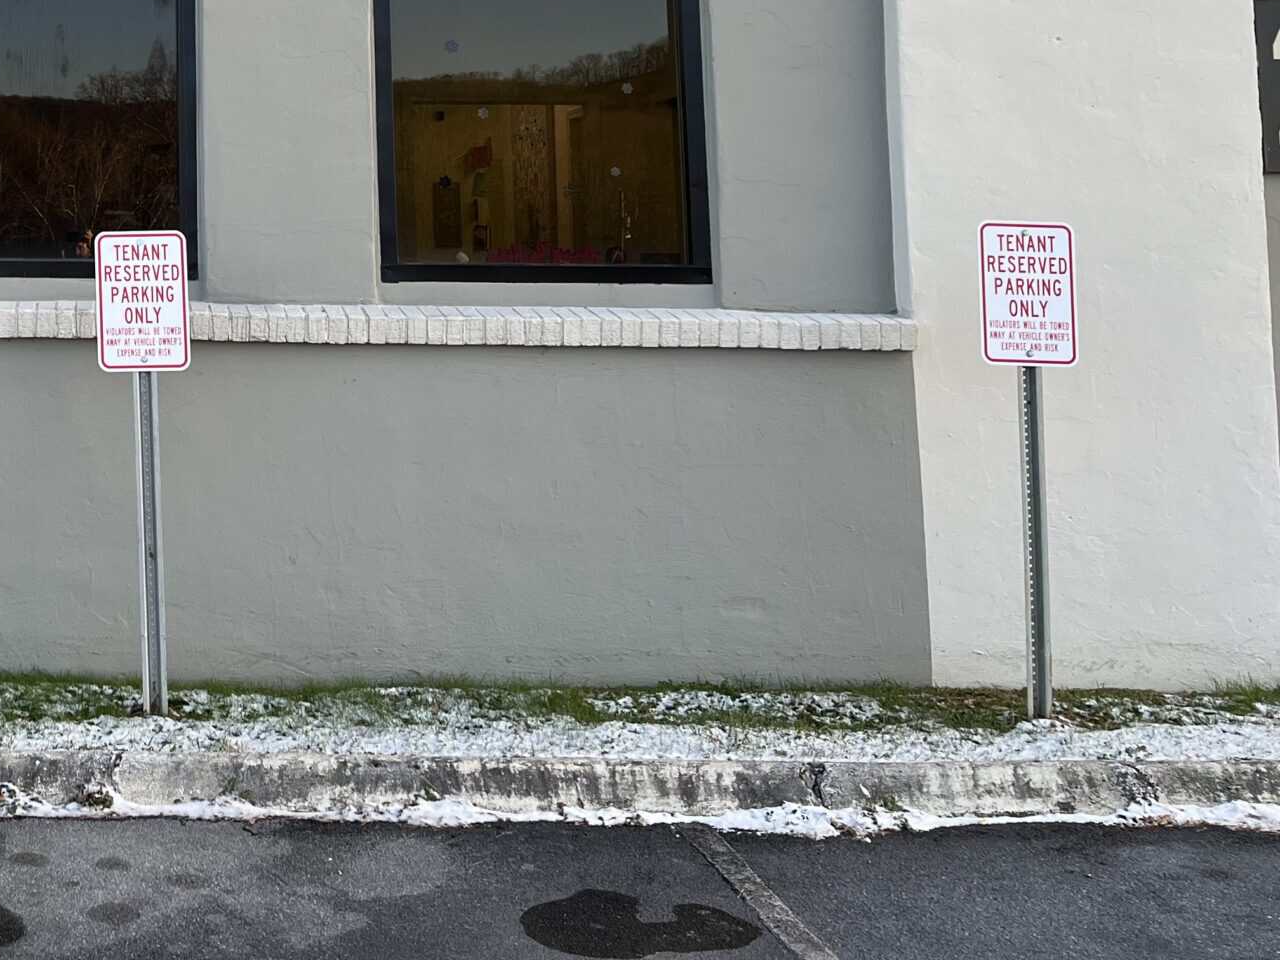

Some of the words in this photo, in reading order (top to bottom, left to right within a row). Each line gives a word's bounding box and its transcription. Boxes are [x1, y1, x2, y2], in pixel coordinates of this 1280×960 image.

[997, 234, 1055, 253] TENANT
[114, 244, 168, 261] TENANT
[104, 264, 180, 282] RESERVED
[987, 256, 1067, 274] RESERVED
[111, 286, 174, 303] PARKING
[994, 277, 1062, 296] PARKING
[124, 307, 161, 324] ONLY
[1009, 300, 1048, 318] ONLY
[989, 320, 1020, 329] VIOLATORS
[1023, 321, 1036, 330] WILL
[1040, 321, 1047, 330] BE
[1050, 322, 1070, 330] TOWED
[989, 331, 1005, 339] AWAY
[1008, 331, 1016, 340] AT
[1018, 332, 1041, 340] VEHICLE
[1001, 342, 1027, 351] EXPENSE
[1029, 343, 1042, 351] AND
[1045, 343, 1058, 352] RISK
